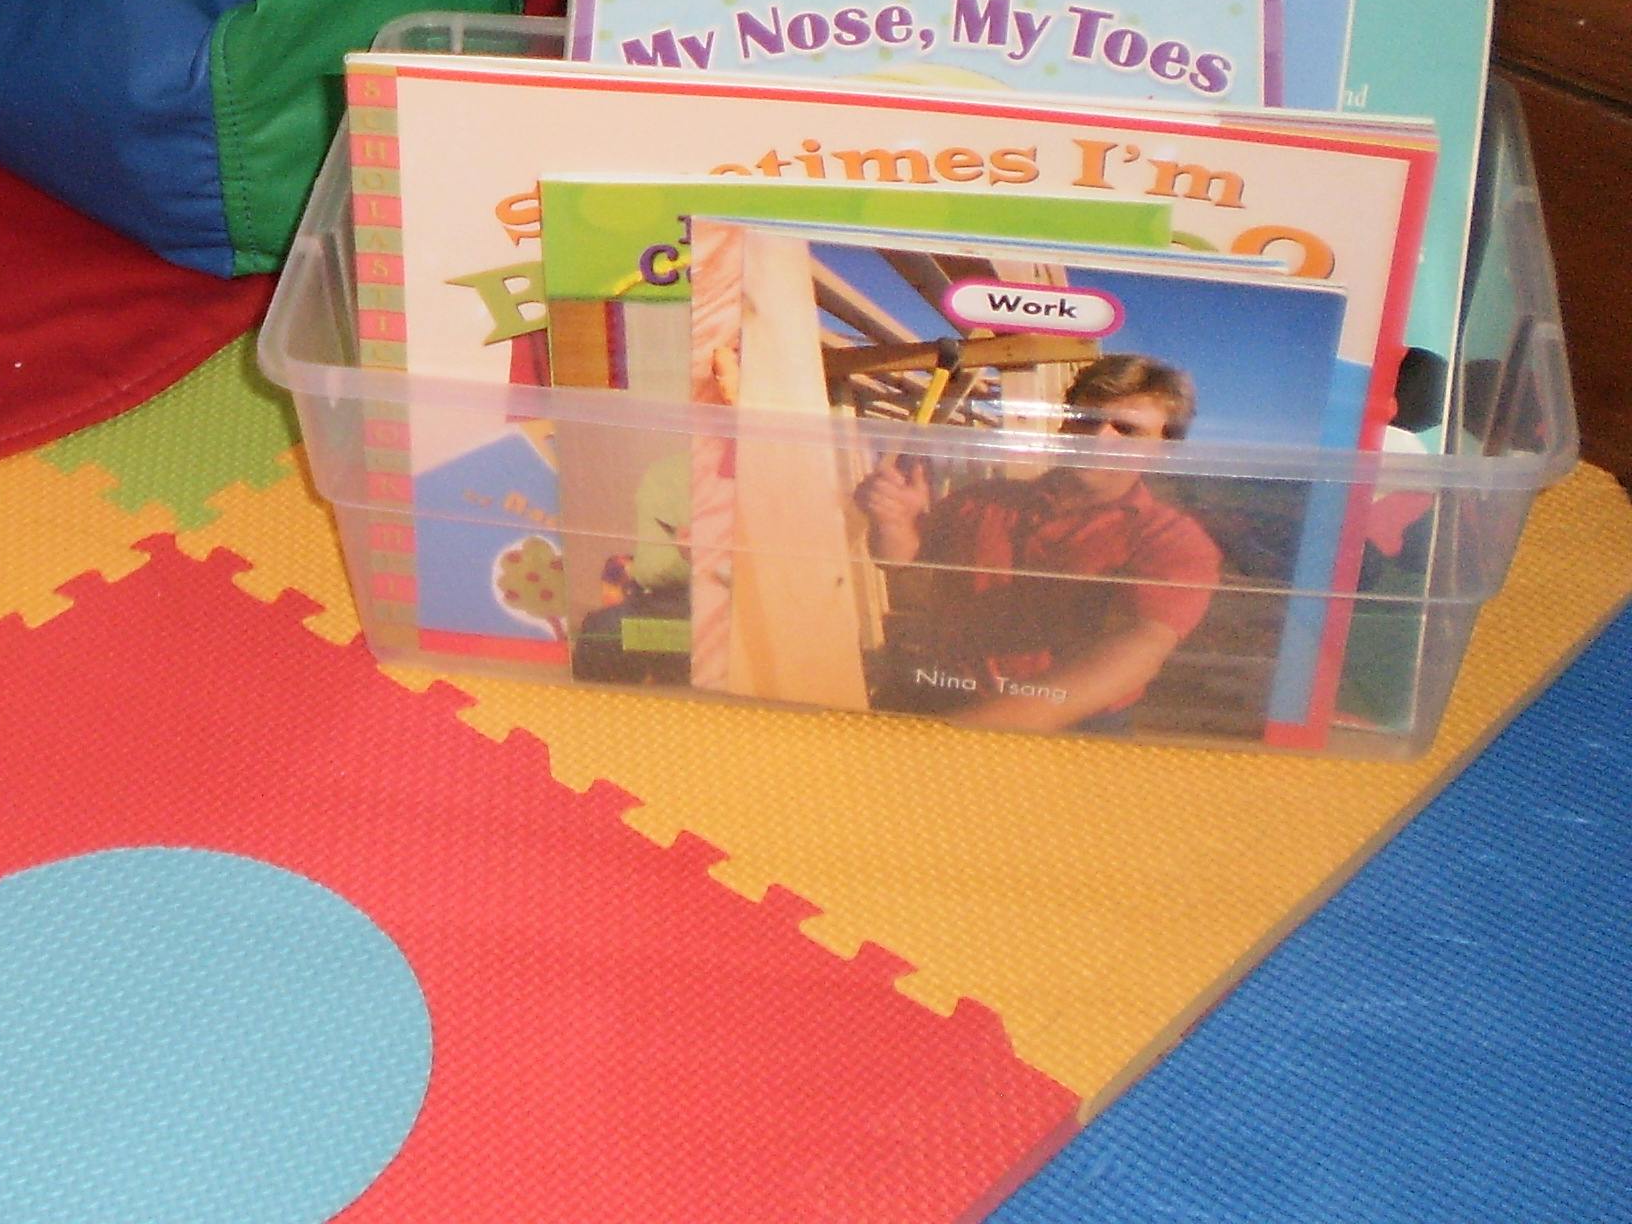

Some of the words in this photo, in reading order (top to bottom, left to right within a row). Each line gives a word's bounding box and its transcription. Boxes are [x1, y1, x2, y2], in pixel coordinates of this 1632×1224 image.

[736, 5, 936, 59] Nose,
[1068, 5, 1232, 93] Toes
[1071, 138, 1246, 209] I'm
[986, 292, 1077, 319] Work
[915, 668, 977, 693] Nina
[998, 677, 1067, 703] Tsang
